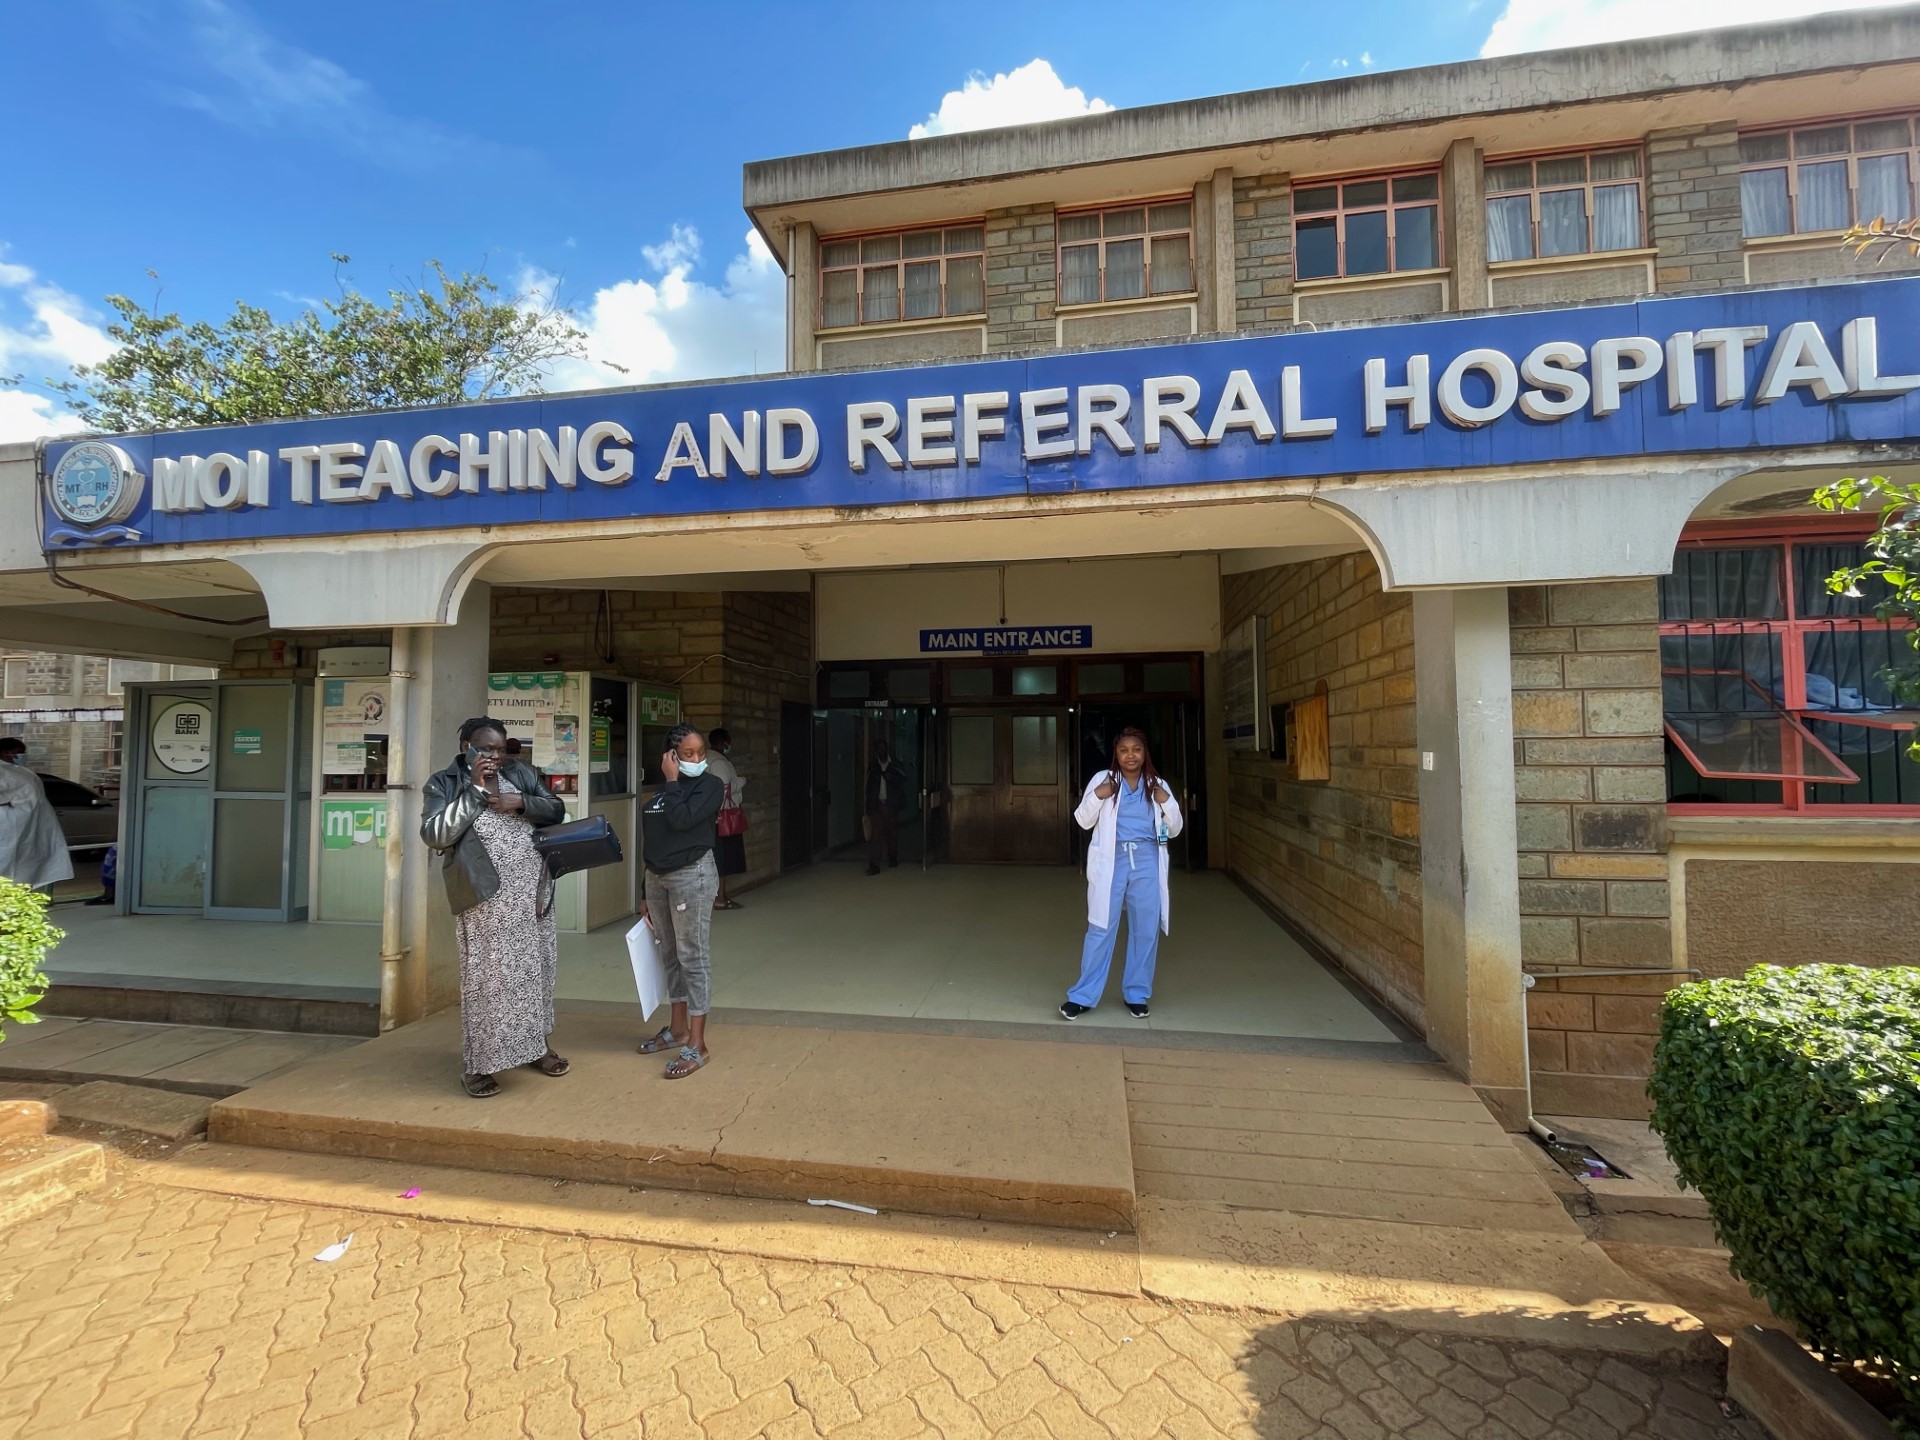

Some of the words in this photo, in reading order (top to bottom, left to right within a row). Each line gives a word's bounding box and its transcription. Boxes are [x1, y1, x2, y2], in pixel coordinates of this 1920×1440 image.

[152, 448, 269, 514] MOI
[279, 421, 634, 505] TEACHING
[654, 407, 820, 482] AND
[847, 365, 1337, 472] REFERRAL
[1364, 316, 1920, 433] HOSPITAL
[65, 484, 81, 494] MT
[95, 482, 109, 492] RH
[928, 632, 977, 648] MAIN
[984, 629, 1082, 648] ENTRANCE
